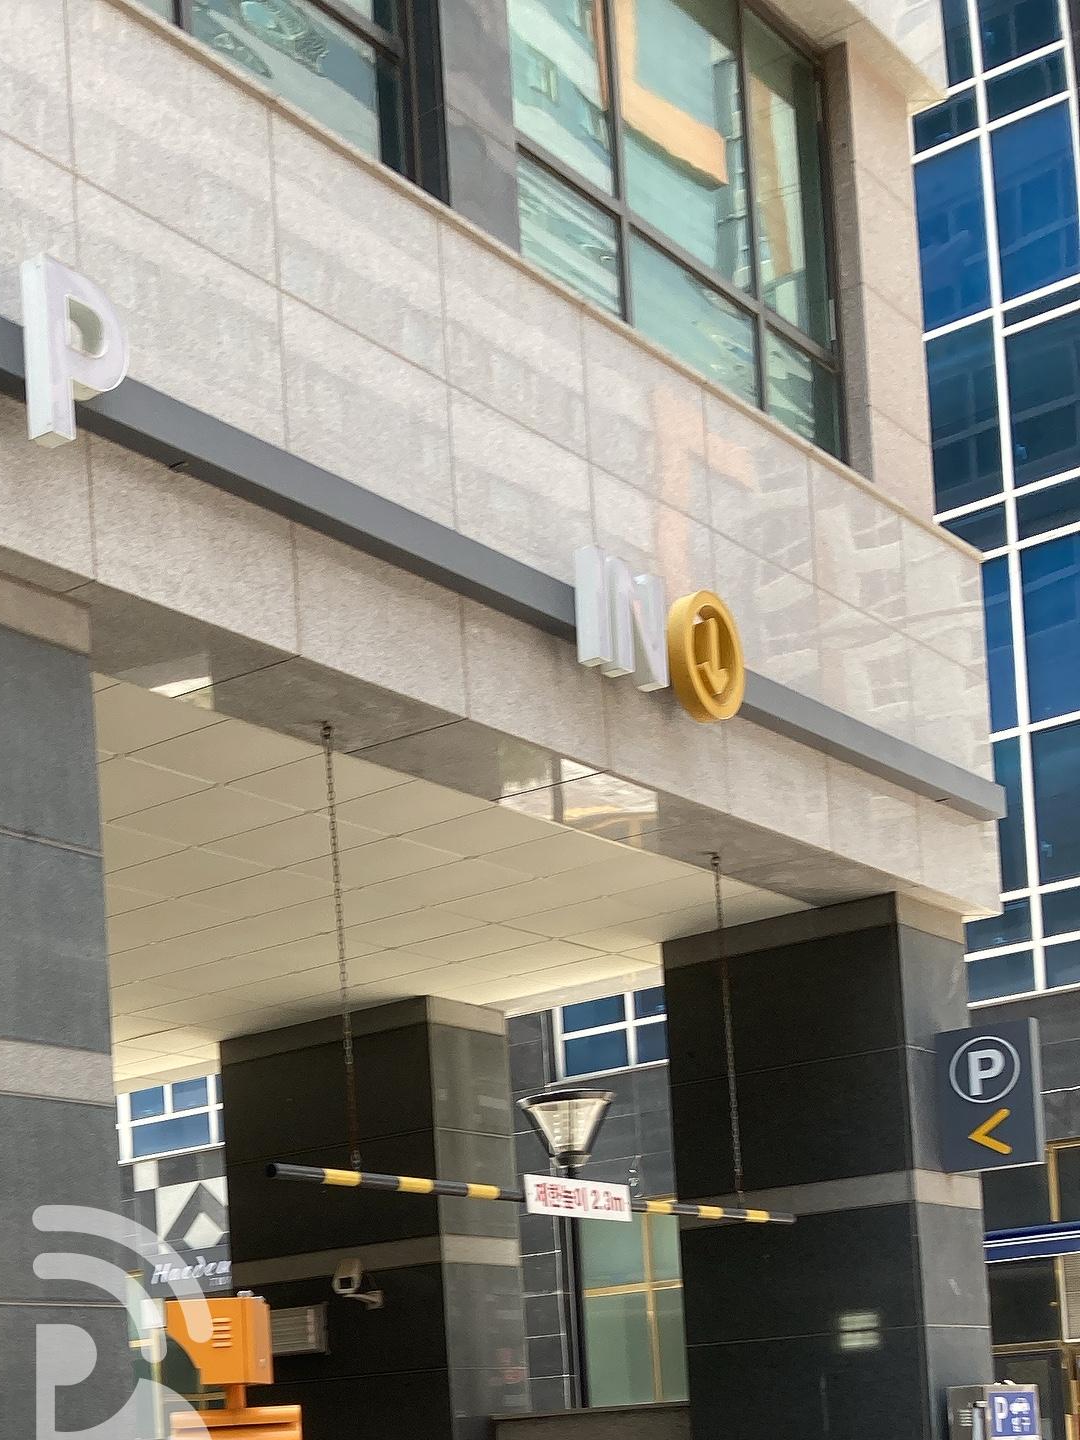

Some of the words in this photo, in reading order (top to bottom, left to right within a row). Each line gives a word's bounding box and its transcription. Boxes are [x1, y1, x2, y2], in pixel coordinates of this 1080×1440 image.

[21, 252, 130, 448] P
[575, 545, 672, 693] IN
[967, 1048, 1006, 1097] P
[534, 1182, 589, 1212] 제한높이
[591, 1188, 624, 1212] 2.3m
[994, 1396, 1008, 1433] P
